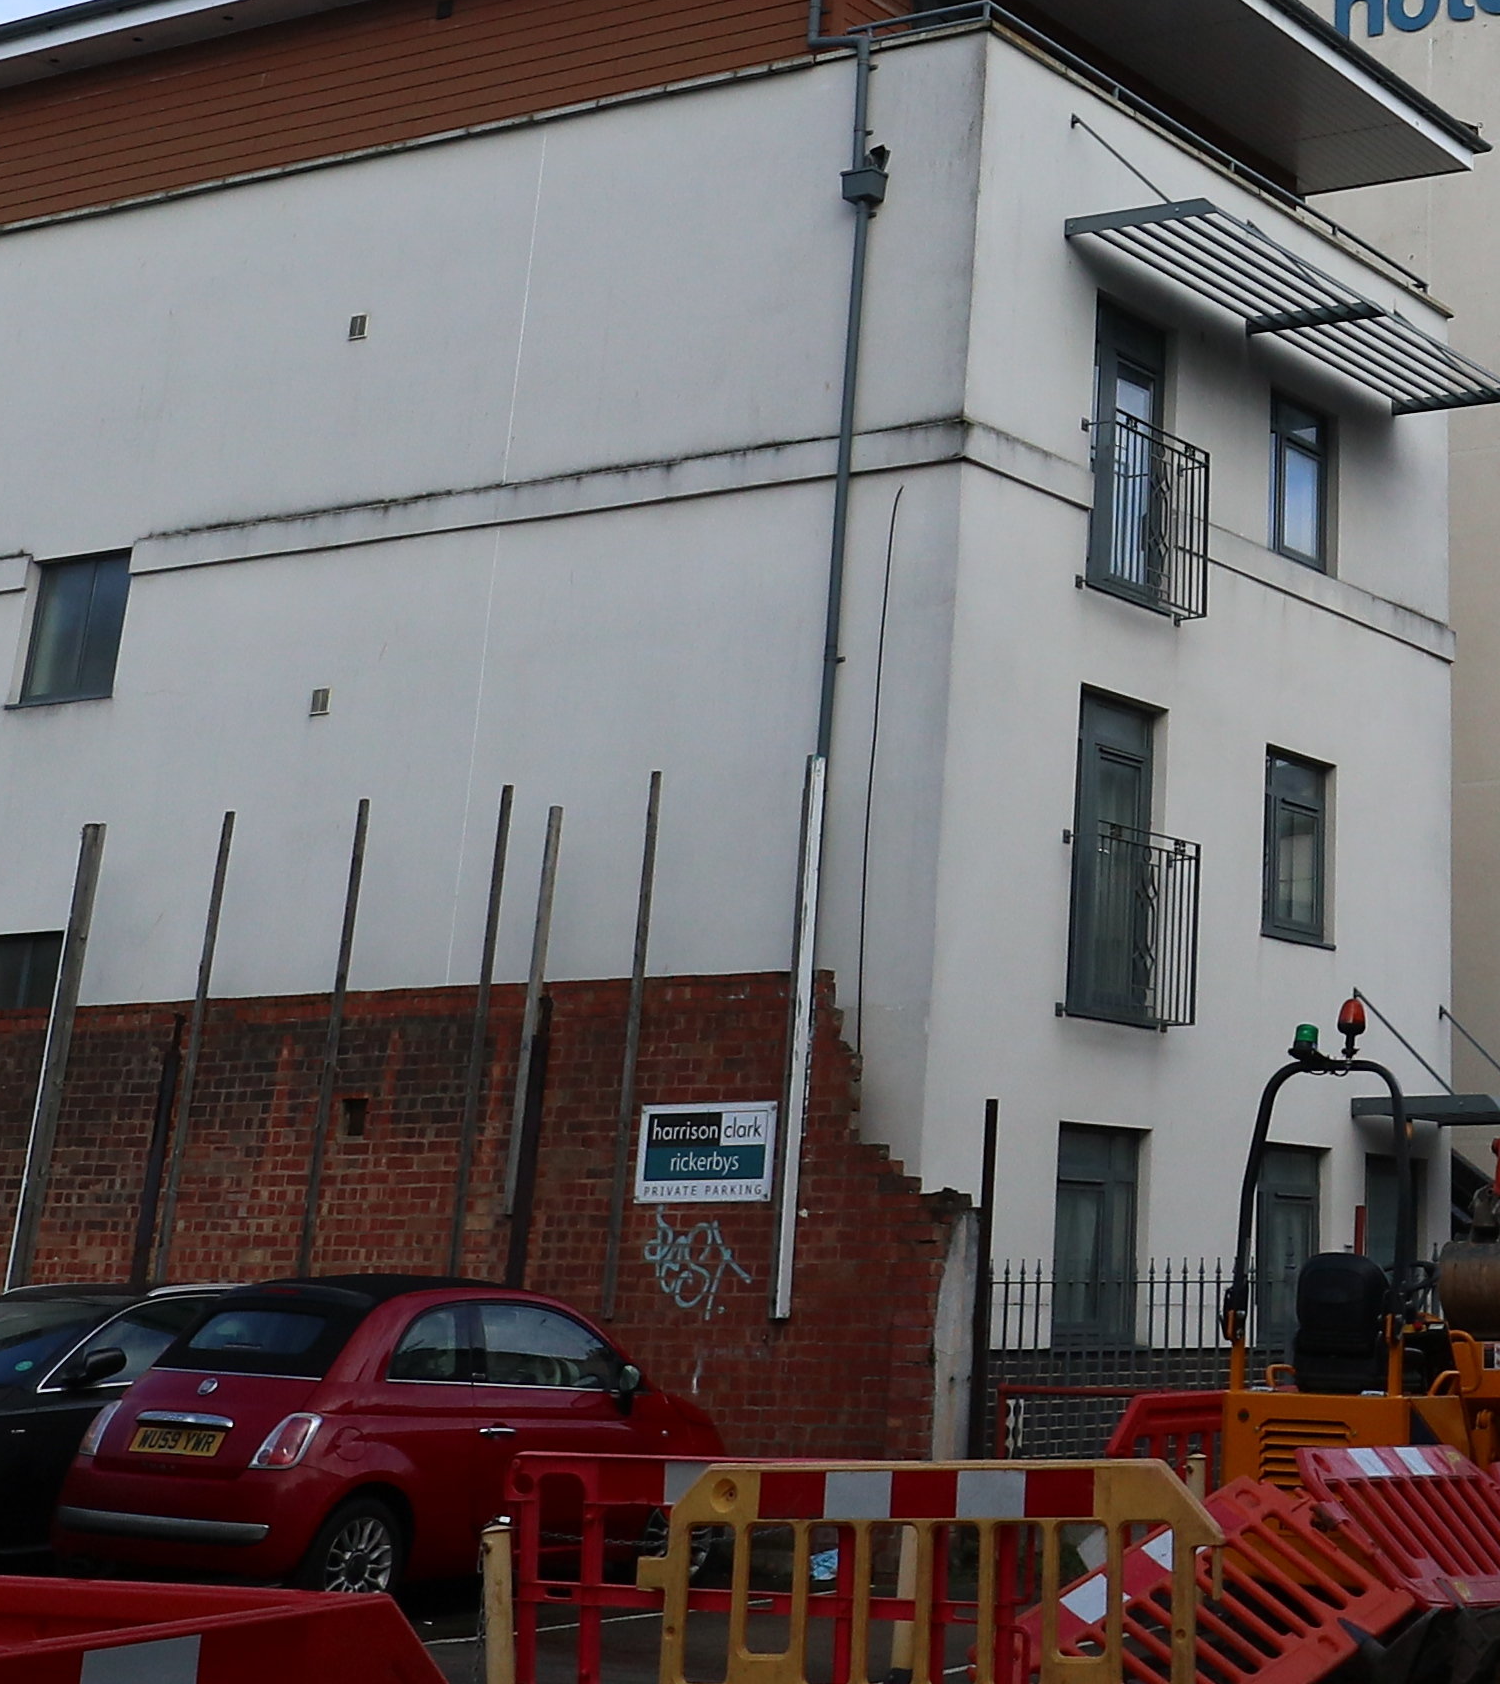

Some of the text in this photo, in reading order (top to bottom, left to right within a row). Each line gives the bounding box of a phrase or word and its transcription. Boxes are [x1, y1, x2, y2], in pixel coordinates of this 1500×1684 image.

[652, 1116, 762, 1140] harrison clark
[670, 1151, 740, 1177] rickerbys
[644, 1184, 762, 1197] PRIVATE PARKING
